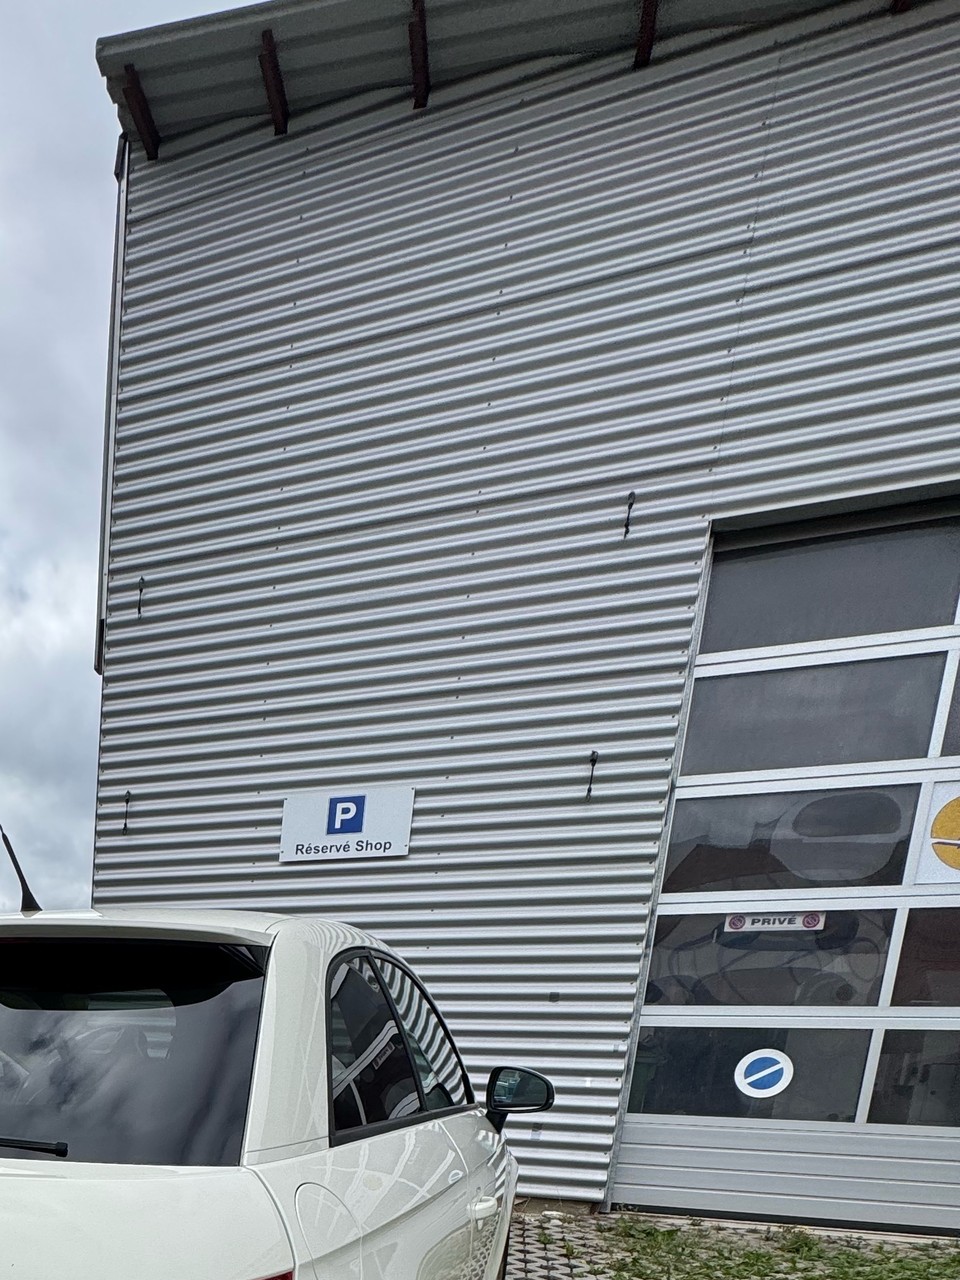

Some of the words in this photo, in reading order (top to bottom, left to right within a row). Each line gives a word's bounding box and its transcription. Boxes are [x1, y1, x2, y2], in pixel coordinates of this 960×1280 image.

[334, 802, 357, 829] P
[295, 841, 350, 855] Réservé
[355, 839, 392, 853] Shop
[750, 915, 797, 926] PRIVÉ
